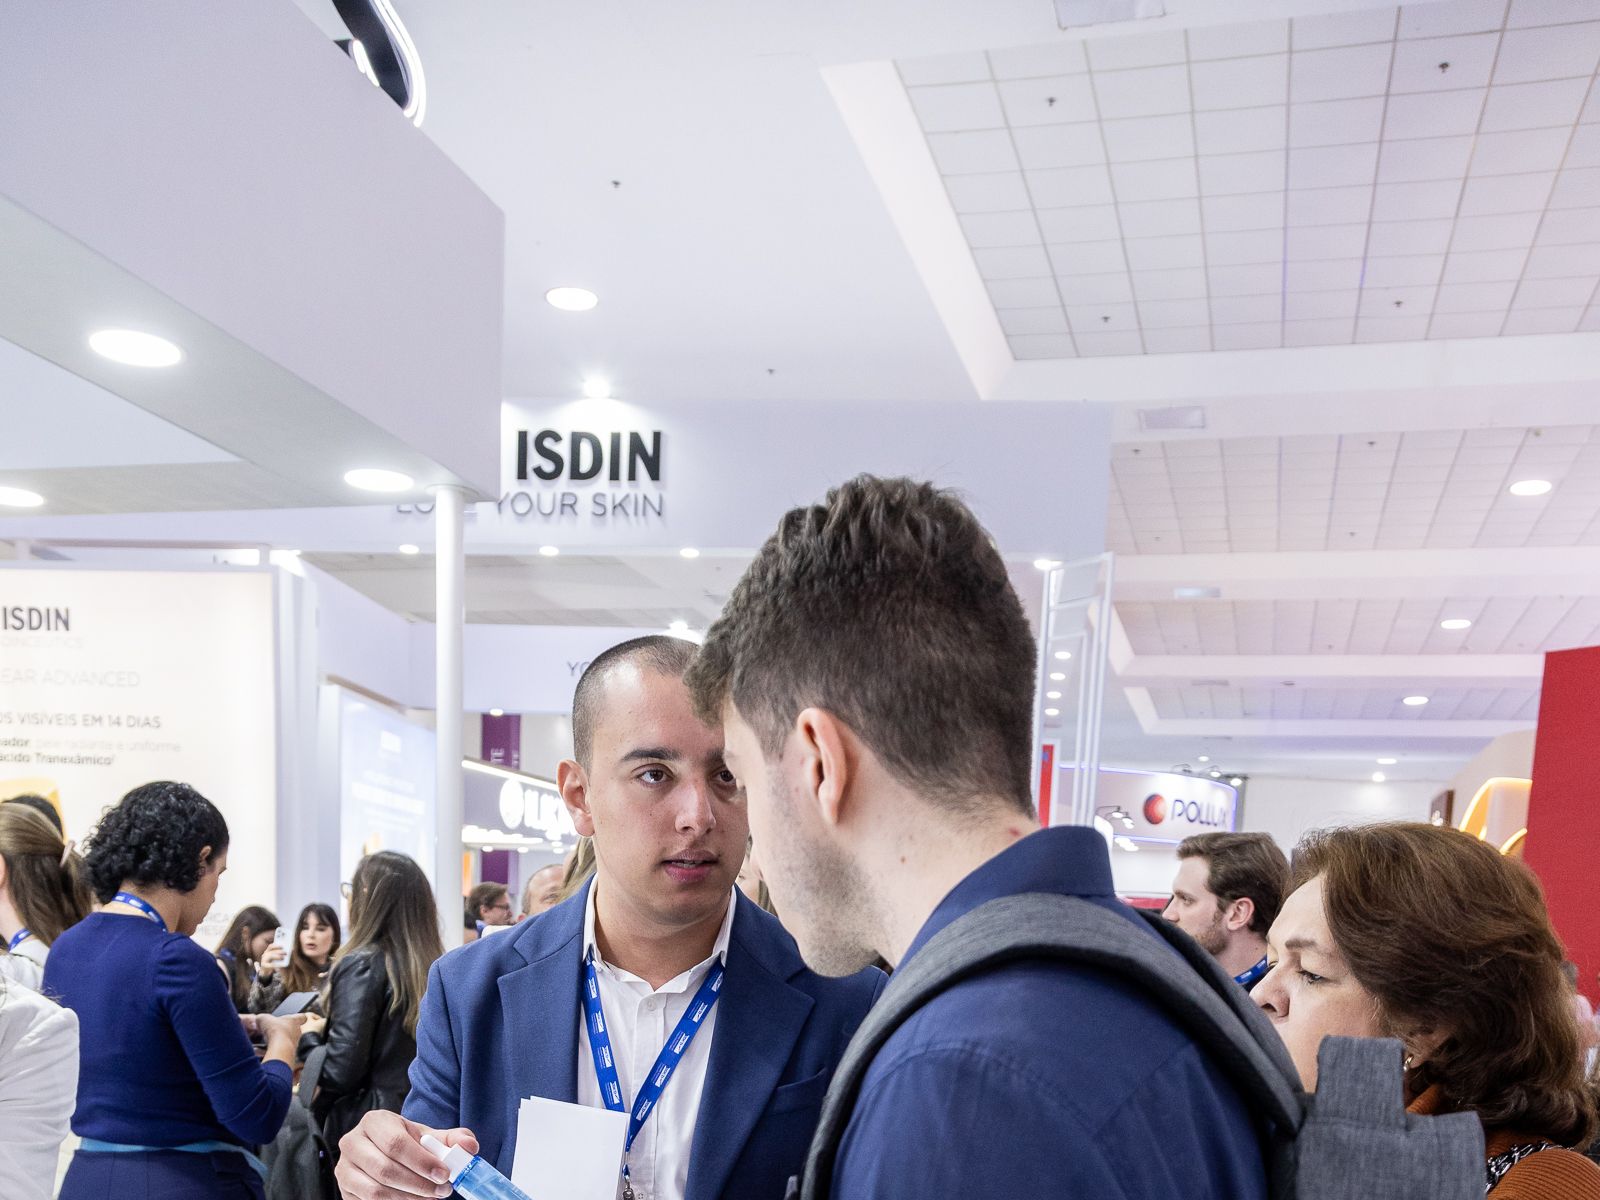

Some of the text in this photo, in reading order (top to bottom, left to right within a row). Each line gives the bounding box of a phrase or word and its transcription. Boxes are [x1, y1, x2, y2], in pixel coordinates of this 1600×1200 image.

[517, 430, 662, 482] ISDIN
[496, 491, 664, 518] YOUR SKIN
[3, 606, 71, 632] ISDIN
[82, 713, 104, 728] EM
[107, 714, 122, 729] 14
[126, 714, 162, 730] DIAS
